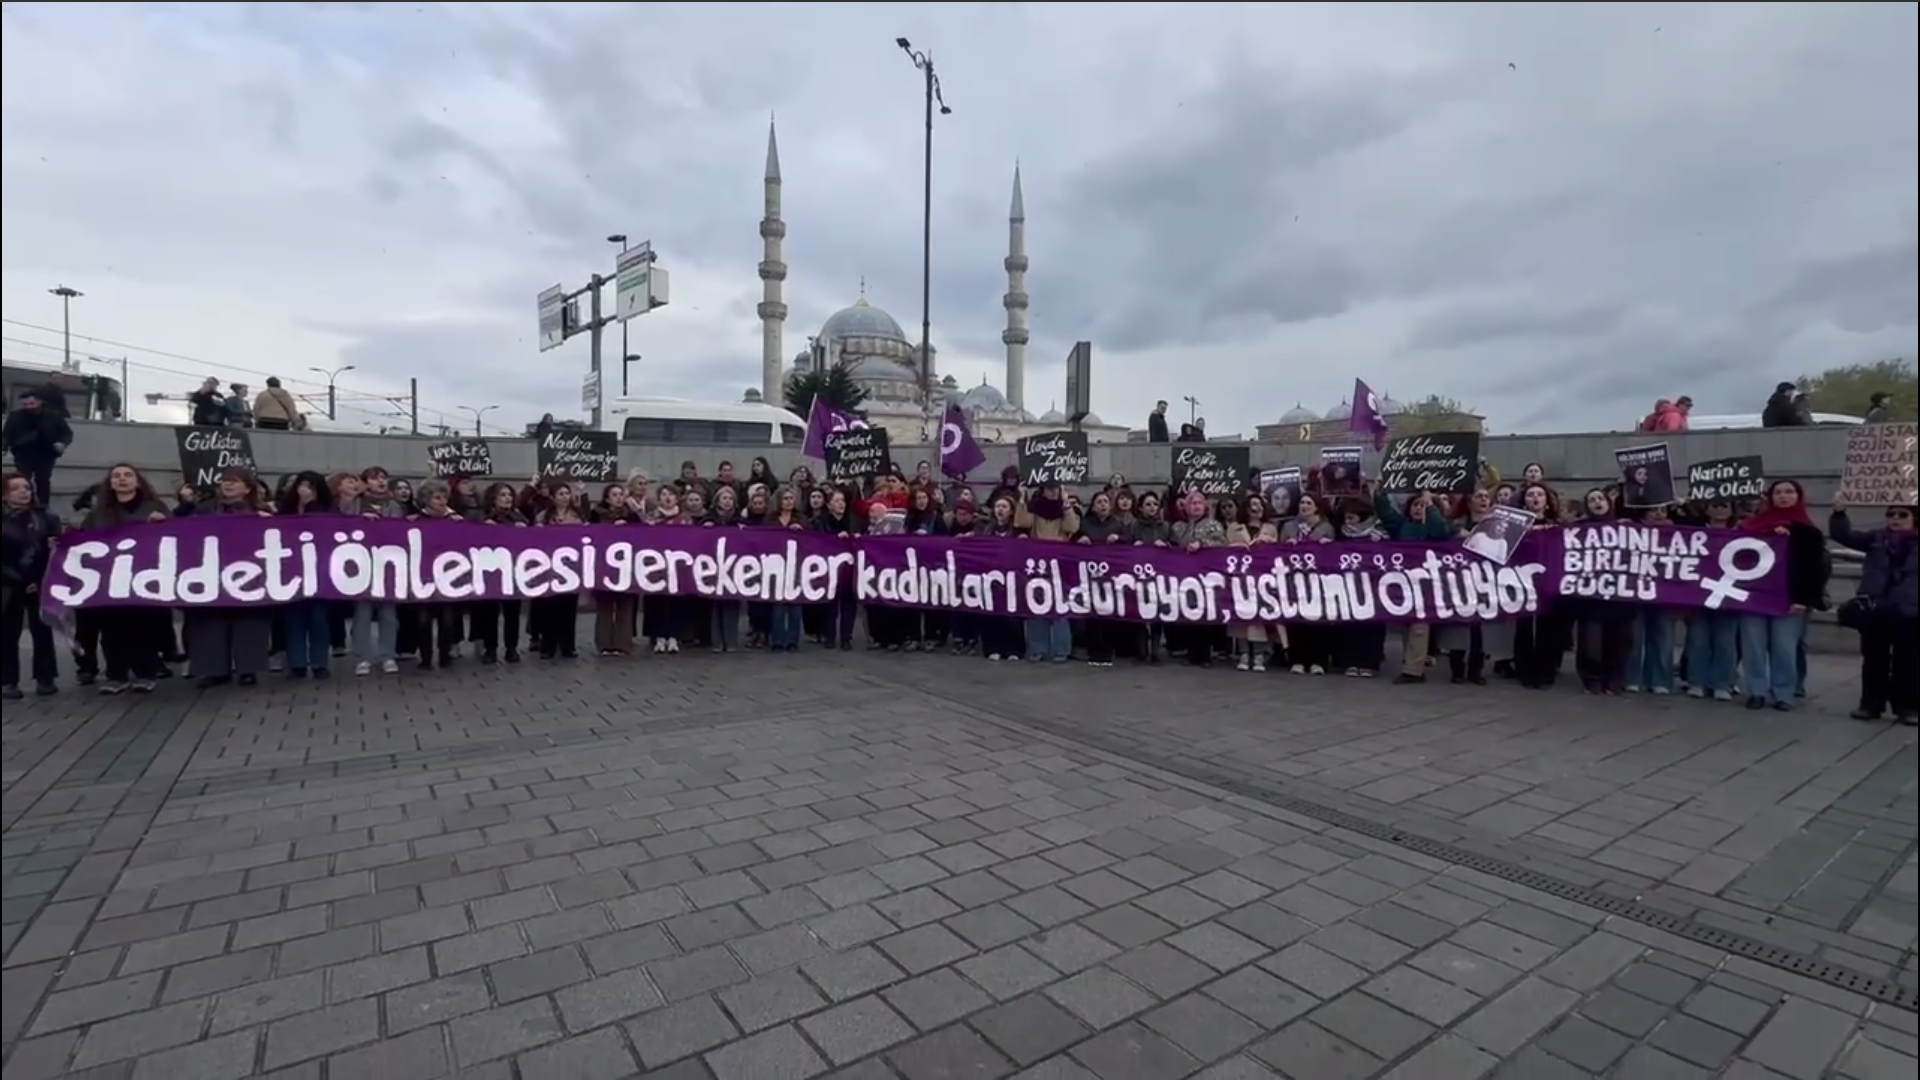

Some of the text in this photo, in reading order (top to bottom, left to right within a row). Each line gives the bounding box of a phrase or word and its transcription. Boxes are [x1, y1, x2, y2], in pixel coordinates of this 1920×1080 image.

[1390, 437, 1455, 459] Yeldana
[1027, 467, 1050, 486] Ne
[1383, 469, 1467, 491] Ne Oldu?
[1690, 462, 1750, 484] Narin'e
[1691, 484, 1716, 500] Ne
[1563, 525, 1709, 556] KADINLAR
[329, 528, 596, 600] önlemesi
[603, 536, 854, 601] gerekenler
[857, 547, 1017, 613] kadınları
[1226, 553, 1376, 621] üstünü
[1373, 549, 1547, 620] örtüyor
[1559, 571, 1657, 600] GÜÇLÜ
